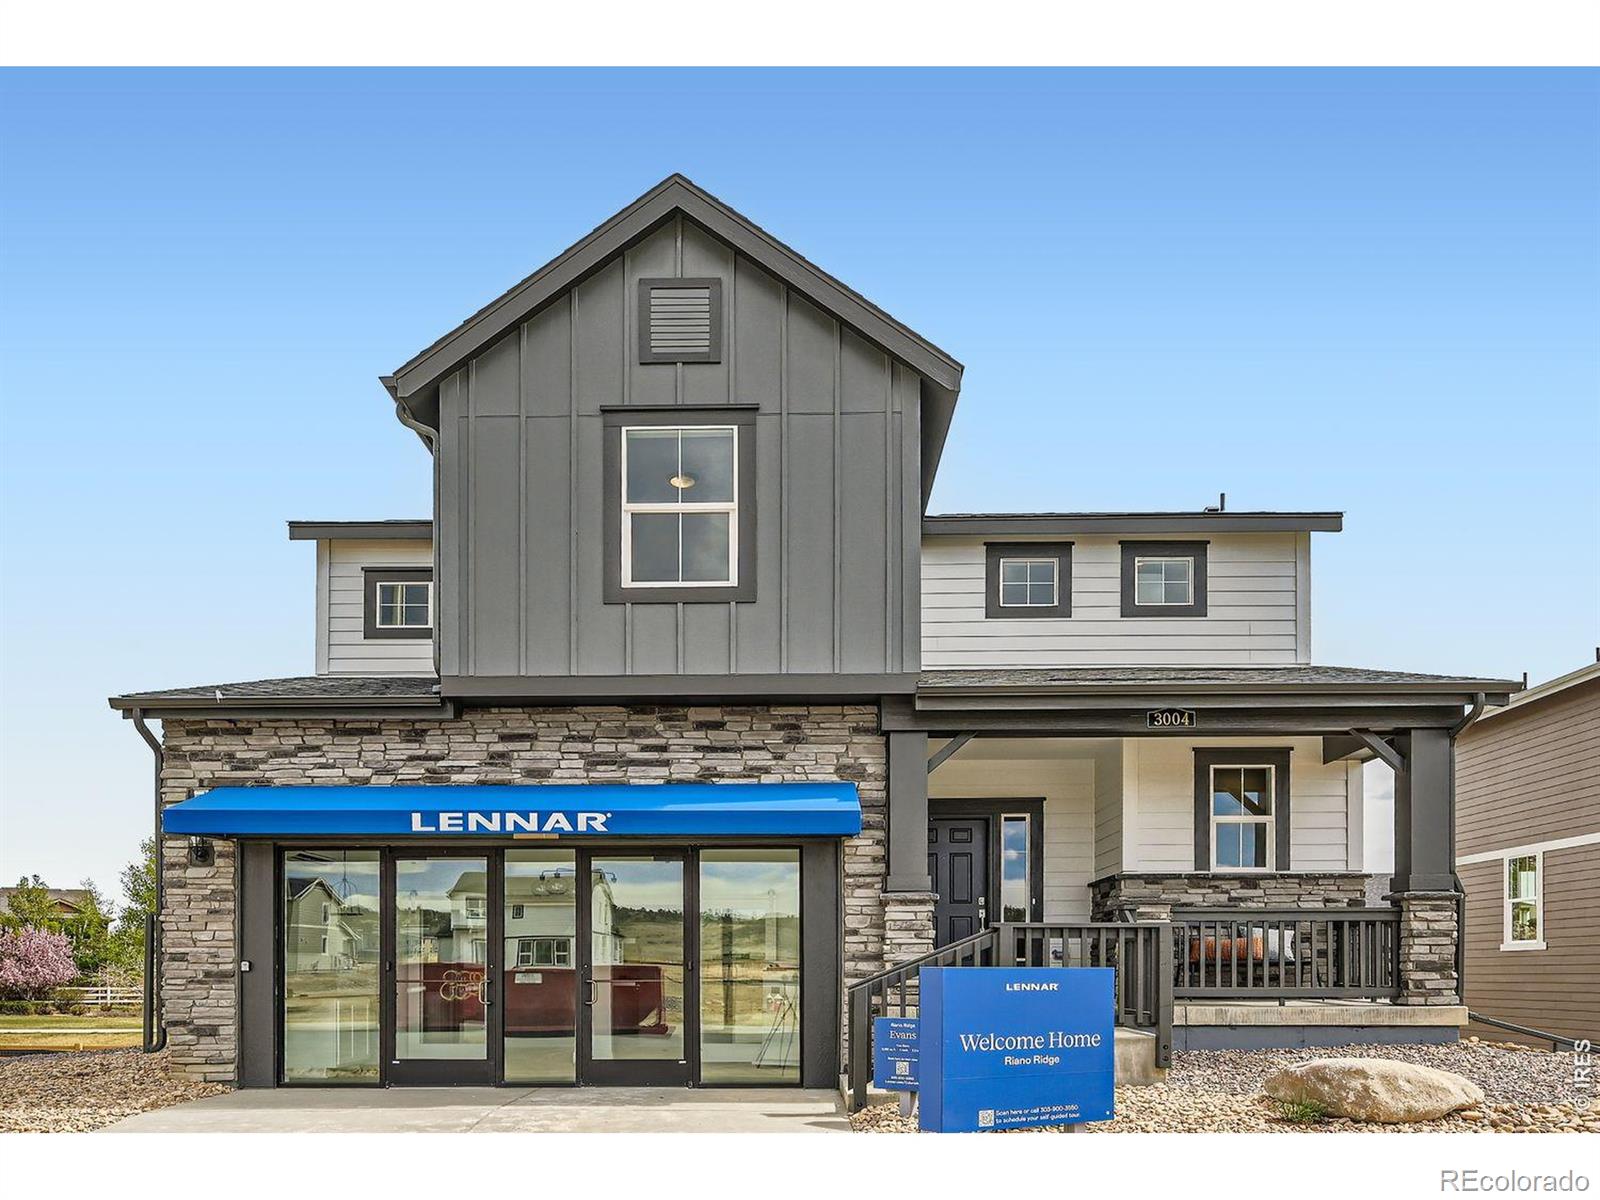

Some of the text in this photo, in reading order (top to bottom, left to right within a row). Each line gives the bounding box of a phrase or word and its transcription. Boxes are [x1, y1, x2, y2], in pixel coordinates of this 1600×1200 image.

[1154, 712, 1190, 726] 3004
[411, 812, 609, 832] LENNAR
[1005, 983, 1059, 991] LENNAR
[889, 1030, 917, 1040] Evans
[960, 1031, 1101, 1052] Welcome Home
[1004, 1054, 1060, 1066] Riano Ridge
